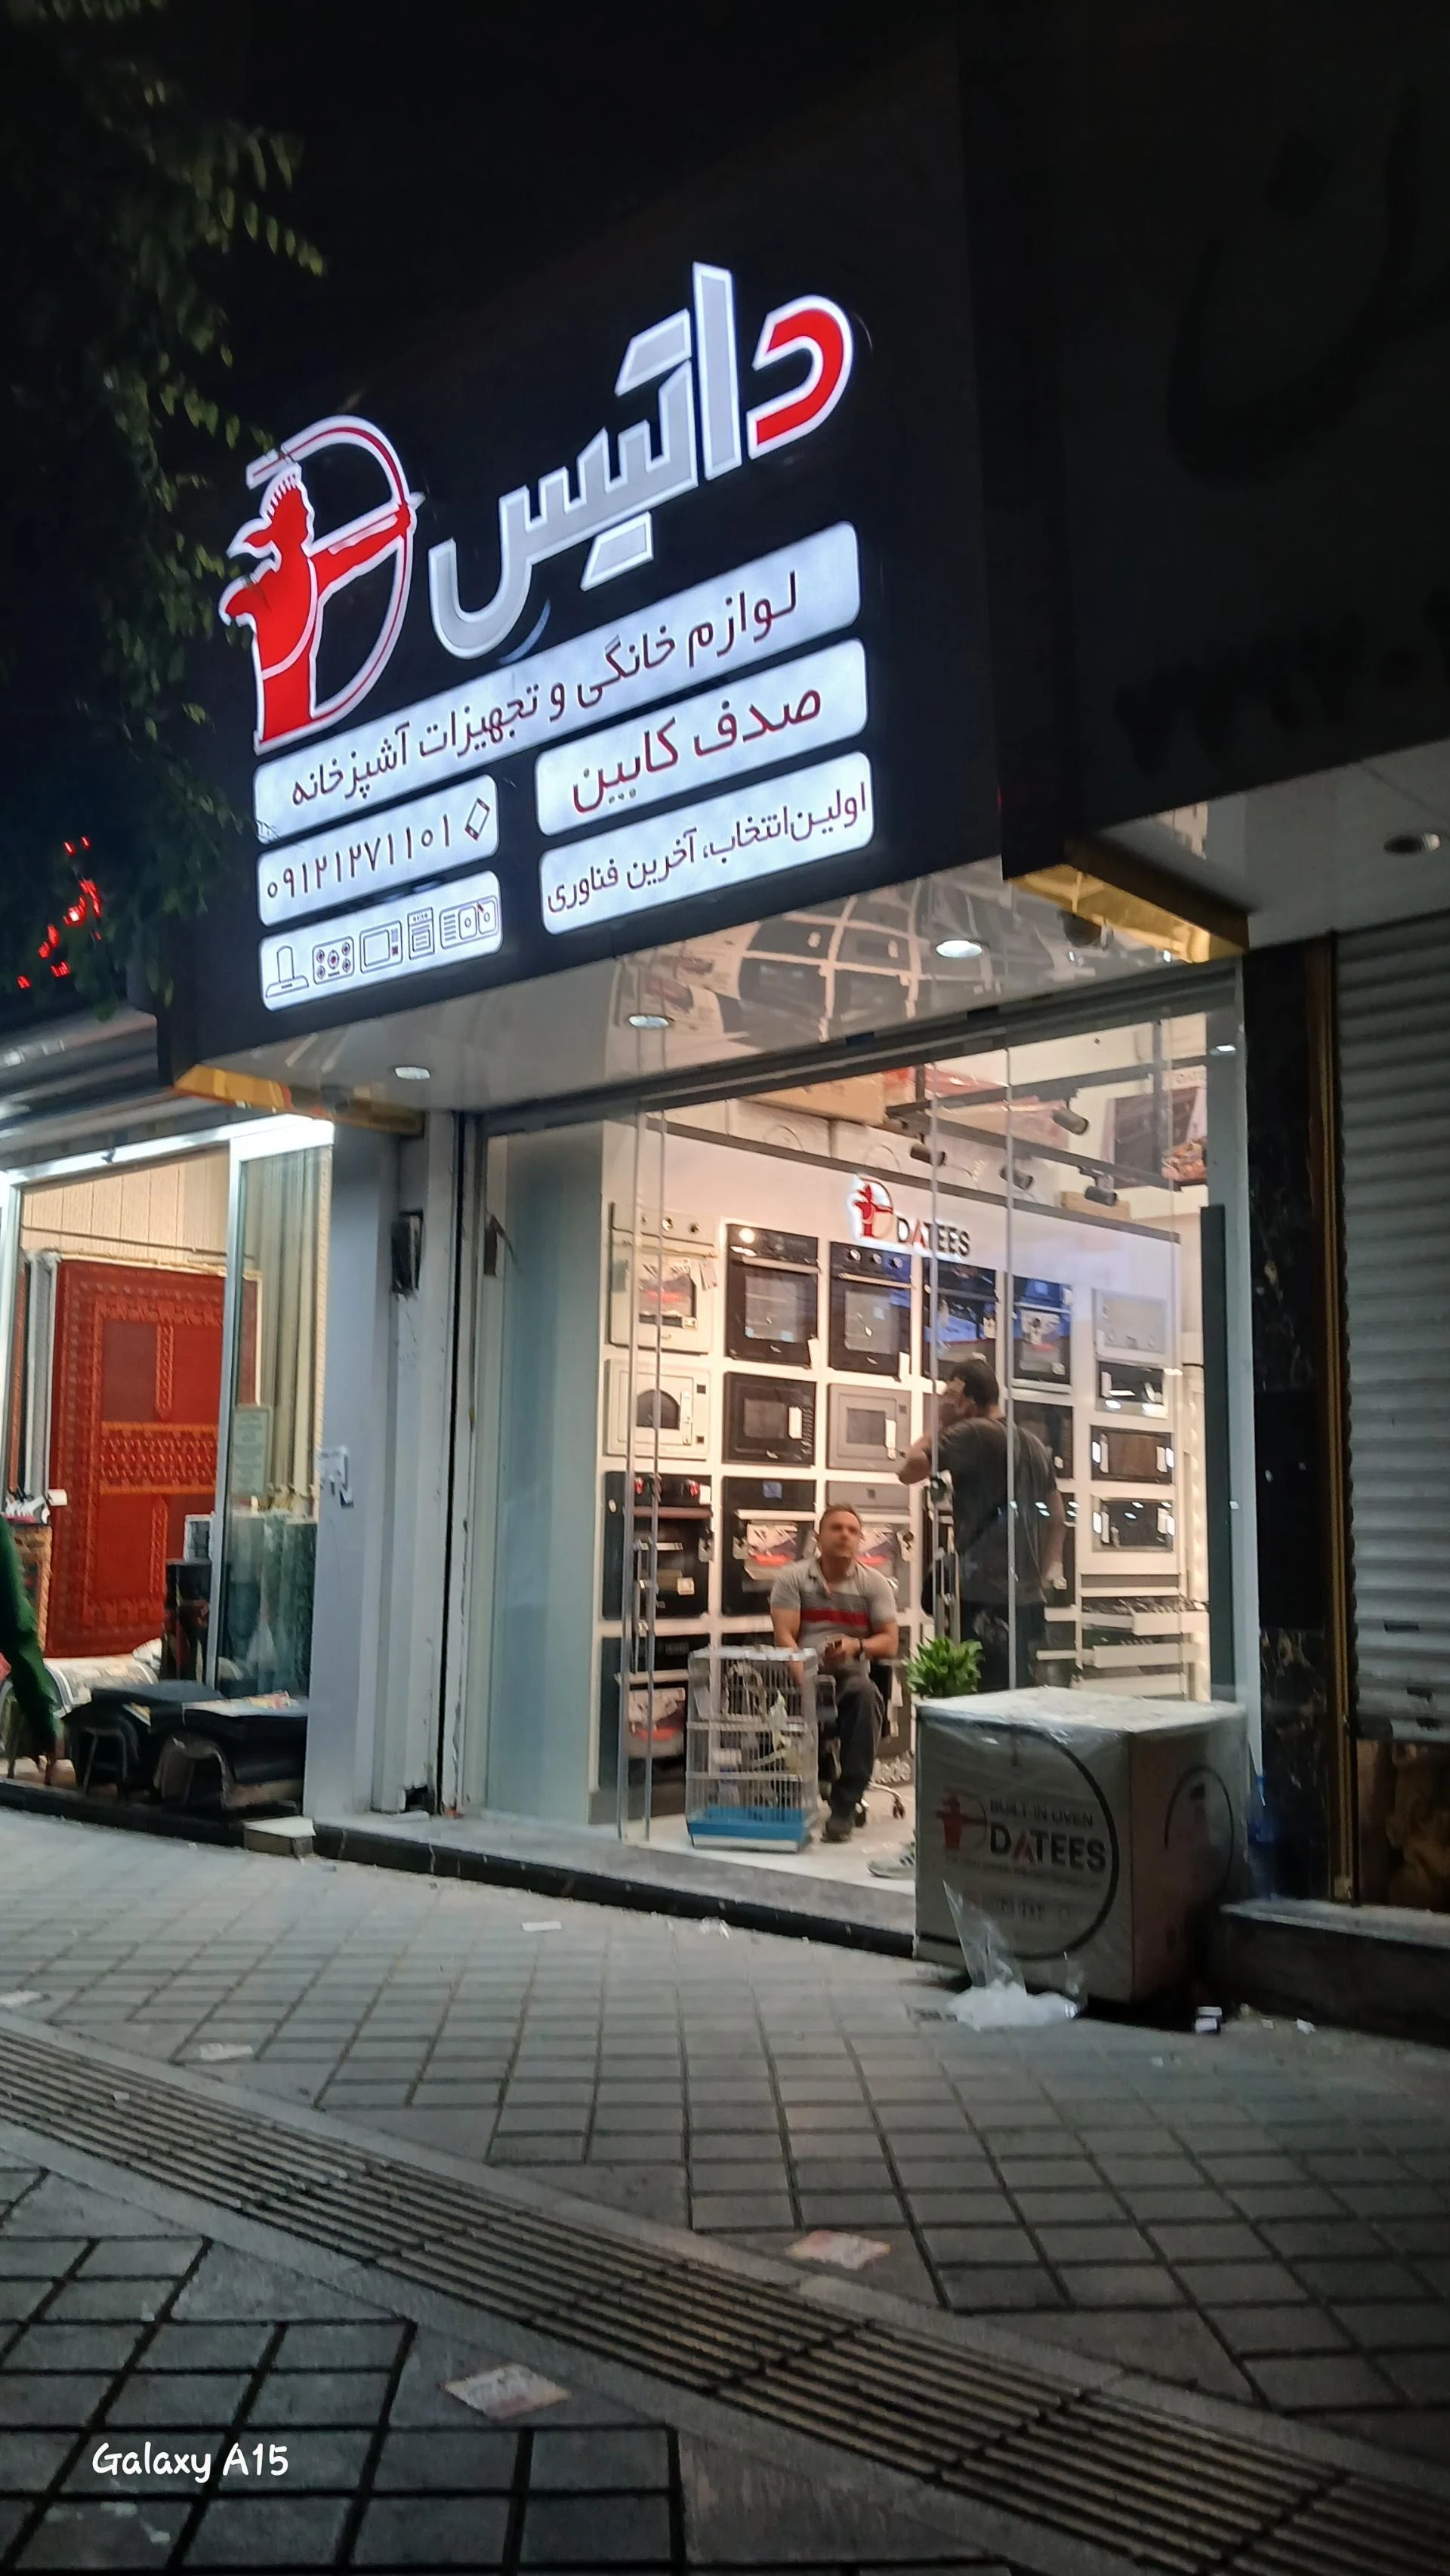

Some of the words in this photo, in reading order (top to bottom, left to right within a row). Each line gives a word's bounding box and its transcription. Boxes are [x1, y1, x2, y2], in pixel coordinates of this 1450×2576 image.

[429, 261, 853, 660] داتیس
[688, 570, 797, 667] لوازم
[549, 682, 566, 723] و
[577, 625, 676, 709] خانگی
[419, 683, 538, 757] تجهیزات
[693, 689, 821, 756] صدف
[292, 721, 410, 806] آشپزخانه
[572, 716, 679, 814] کابین
[790, 782, 867, 841] اولین
[267, 814, 451, 898] ۰۹۱۲۱۲۷۱۱۰۱
[548, 858, 619, 913] فناوری
[627, 827, 696, 889] آخرین
[990, 1821, 1106, 1872] DATEES
